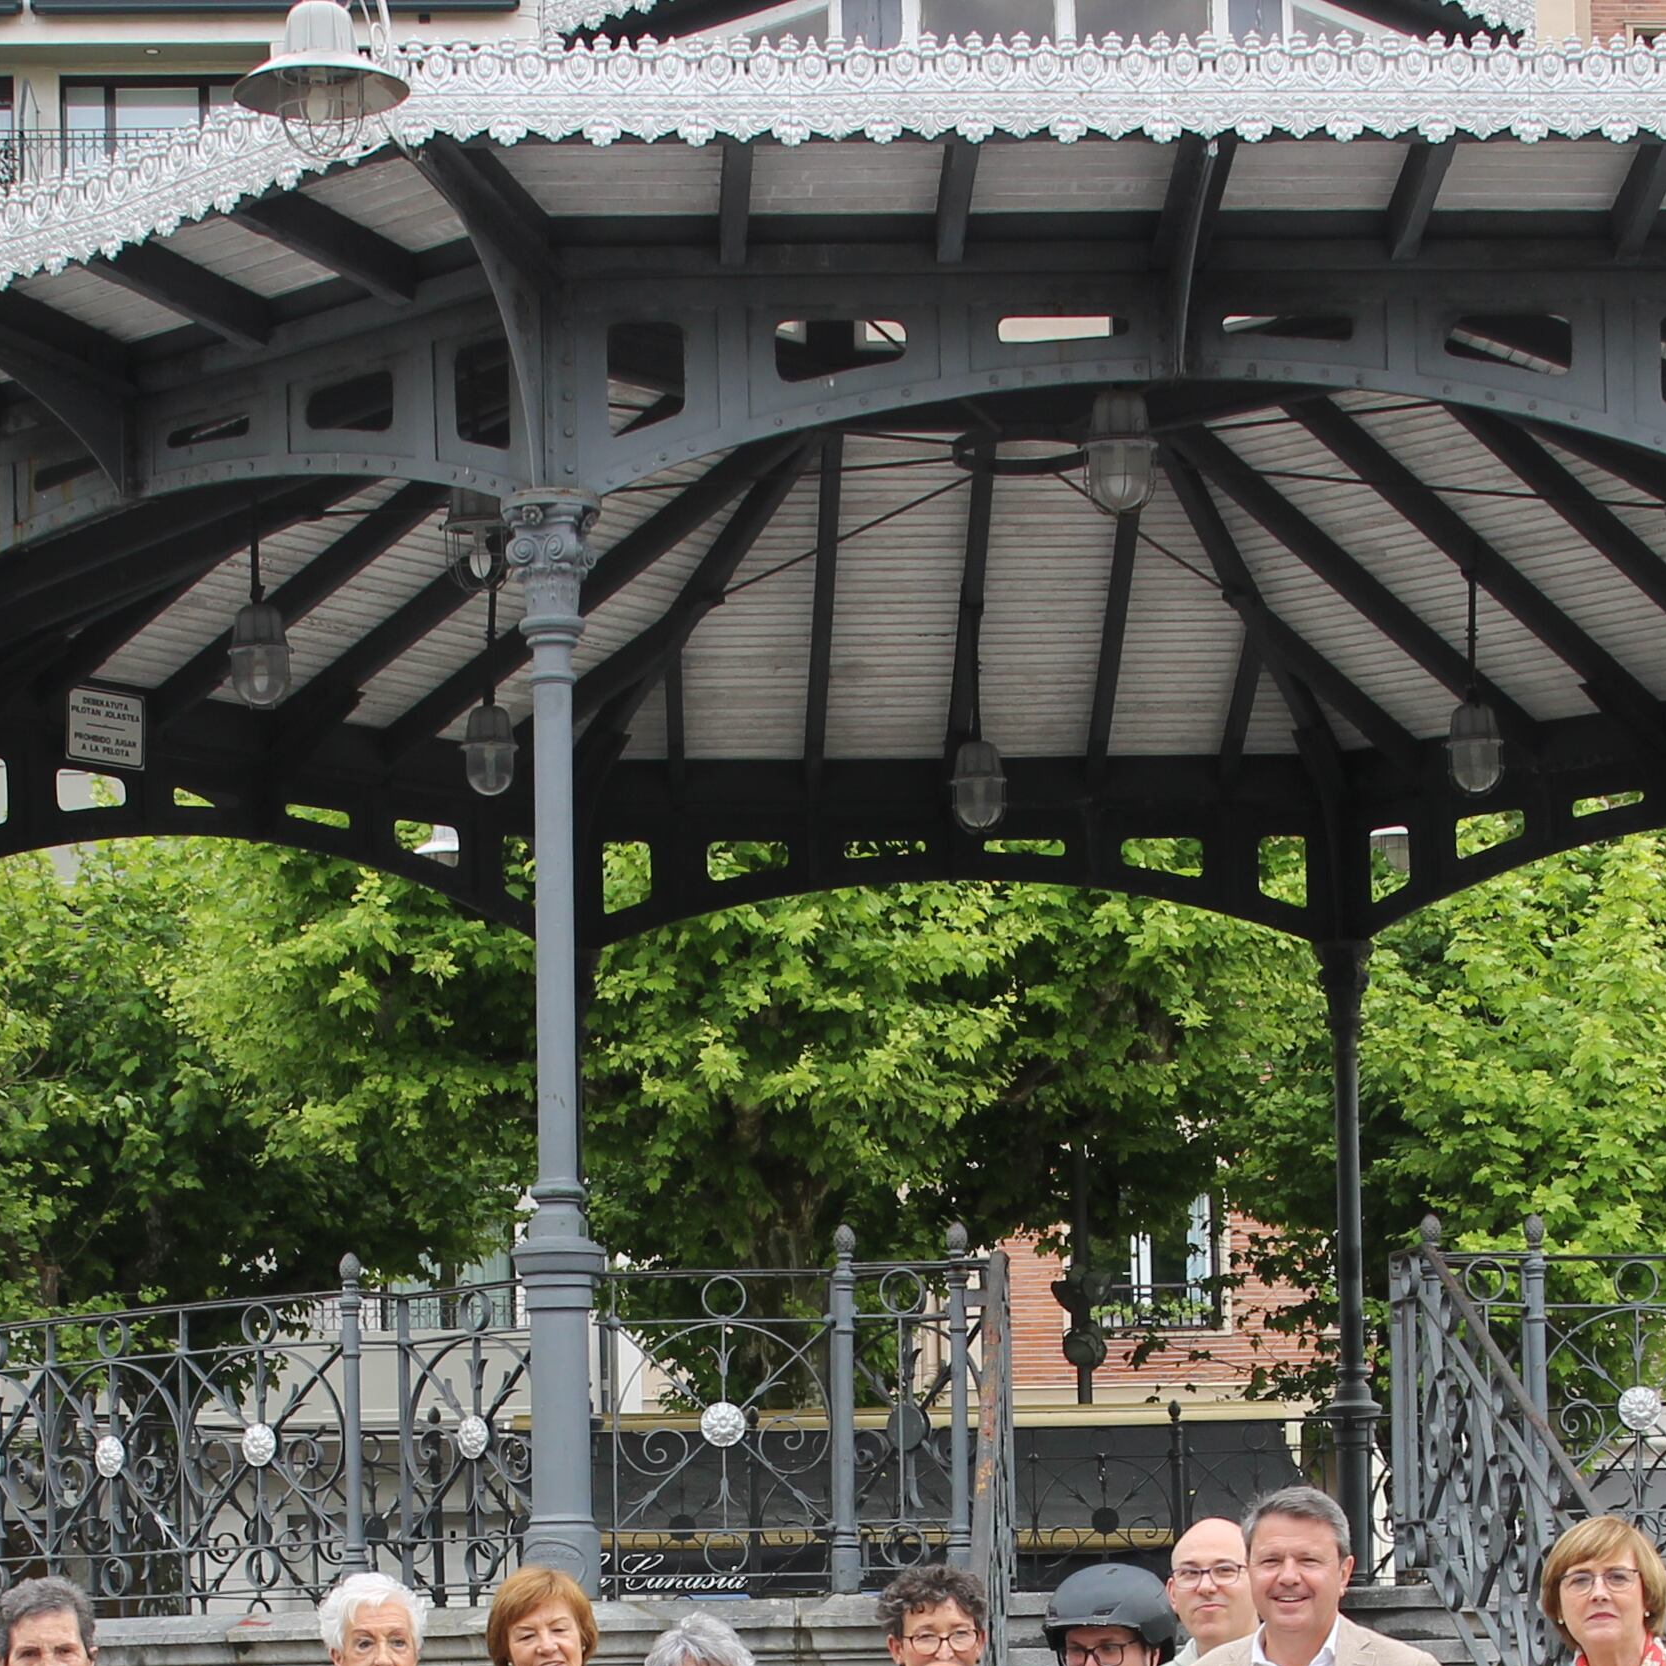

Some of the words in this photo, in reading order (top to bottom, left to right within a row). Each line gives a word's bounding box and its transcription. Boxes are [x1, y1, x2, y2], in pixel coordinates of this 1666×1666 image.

[71, 705, 101, 716] PILOTAN
[104, 711, 140, 723] JOLASTEA
[74, 731, 111, 745] PROHIBIDO
[114, 738, 137, 748] JUGAR
[90, 744, 99, 752] LA
[102, 746, 130, 757] PELOTA
